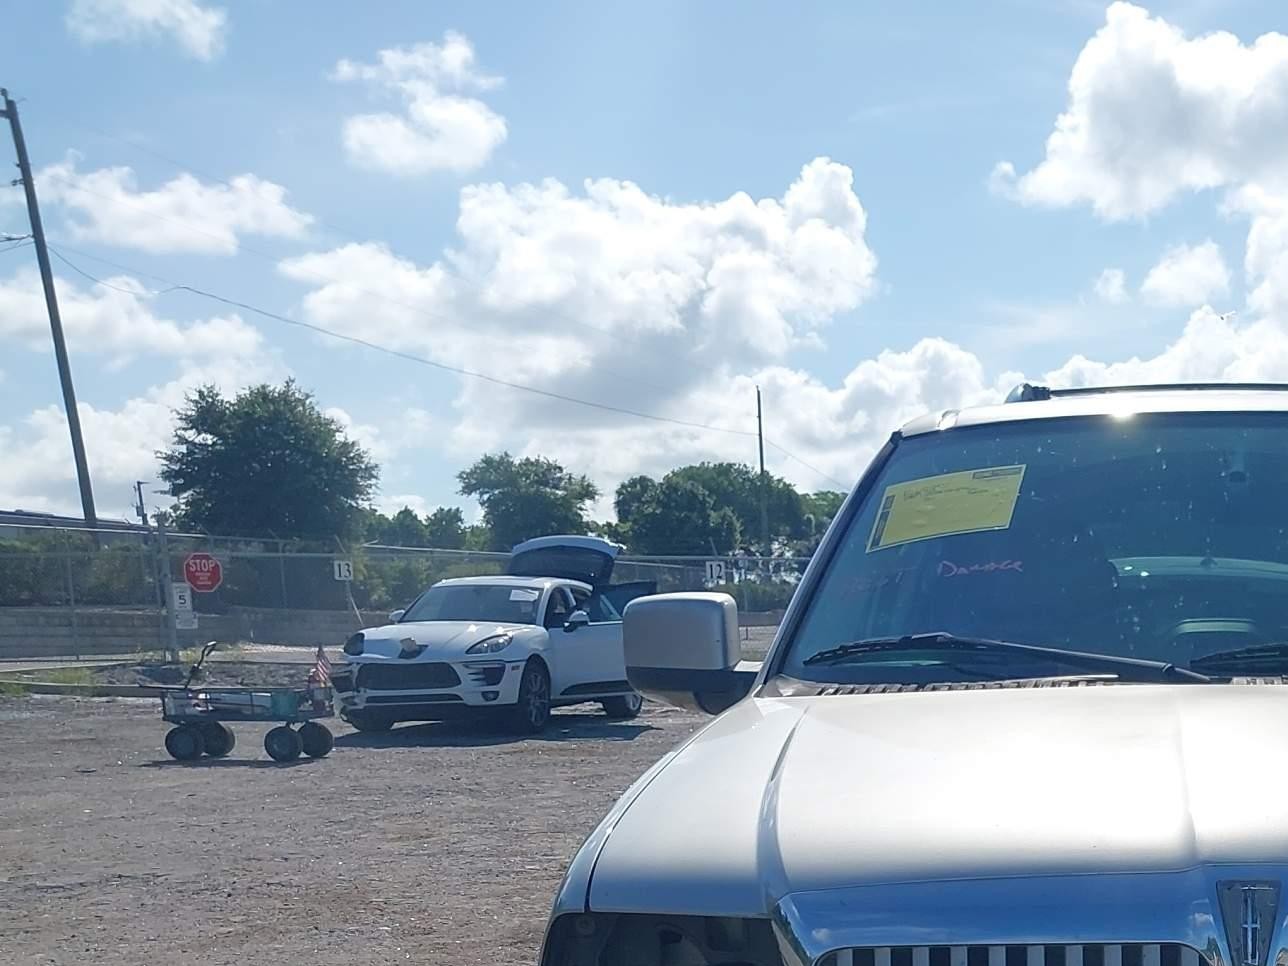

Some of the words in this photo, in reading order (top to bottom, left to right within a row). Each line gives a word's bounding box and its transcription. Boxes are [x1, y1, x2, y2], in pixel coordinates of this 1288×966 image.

[189, 559, 216, 572] STOP
[337, 562, 352, 578] 13
[709, 563, 723, 580] 12
[177, 594, 187, 605] 5
